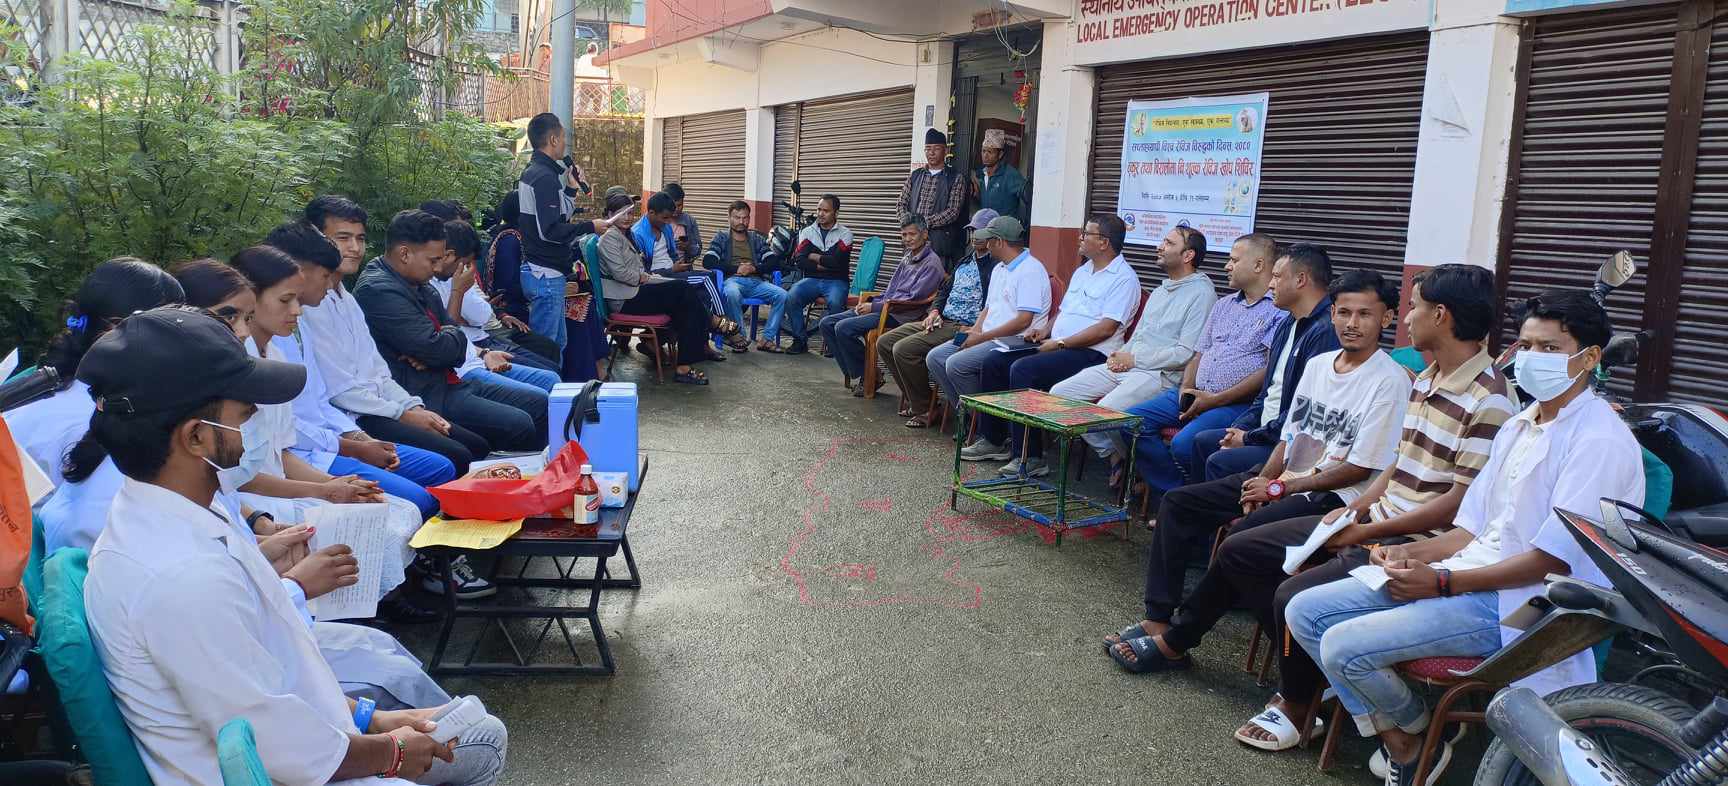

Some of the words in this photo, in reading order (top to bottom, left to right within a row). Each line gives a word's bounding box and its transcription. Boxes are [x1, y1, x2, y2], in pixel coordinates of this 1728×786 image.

[1077, 20, 1110, 43] LOCAL
[1113, 9, 1180, 39] EMERGENCY
[1184, 0, 1259, 28] OPERATION
